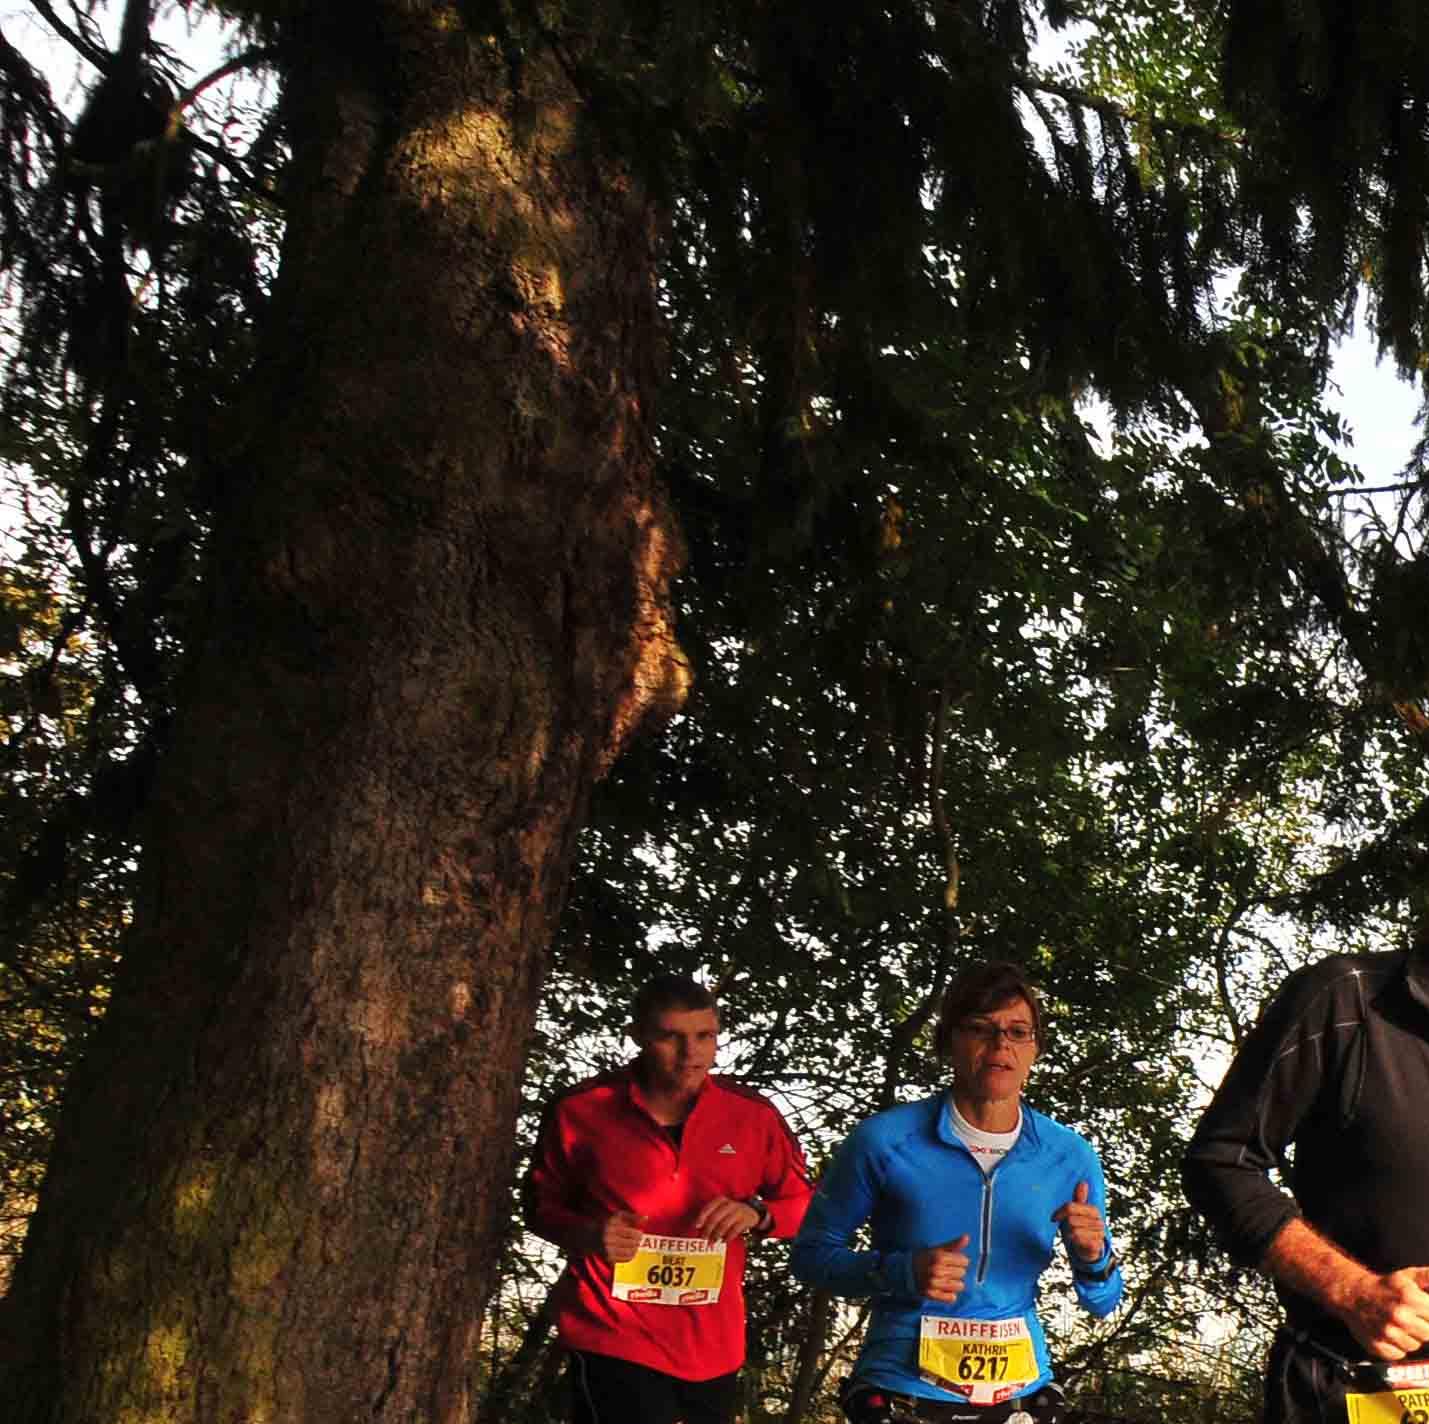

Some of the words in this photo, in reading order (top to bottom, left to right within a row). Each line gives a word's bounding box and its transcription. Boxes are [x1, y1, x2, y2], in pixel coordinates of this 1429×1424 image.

[647, 1265, 696, 1287] 6037
[937, 1320, 1021, 1338] RAIFFEISEN
[958, 1356, 1009, 1380] 6217
